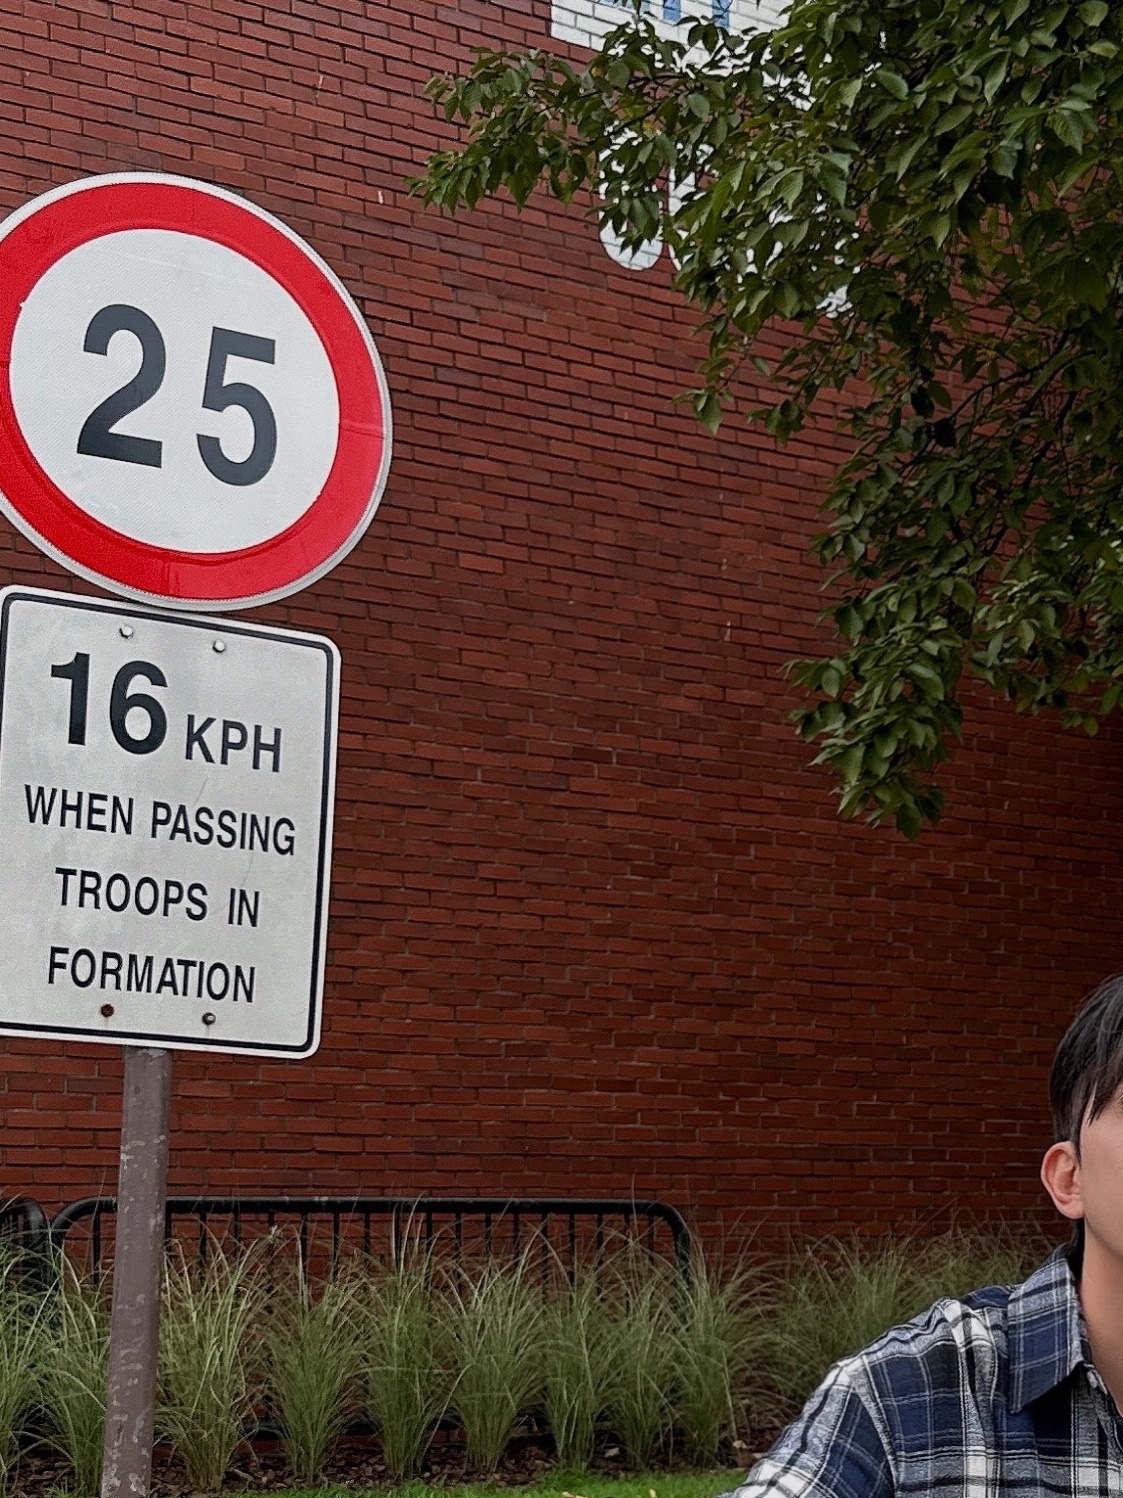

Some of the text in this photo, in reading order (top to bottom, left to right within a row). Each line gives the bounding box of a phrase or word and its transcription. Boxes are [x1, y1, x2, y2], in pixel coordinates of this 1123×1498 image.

[77, 304, 277, 486] 25
[50, 652, 282, 773] 16 KPH
[24, 784, 296, 856] WHEN PASSING
[54, 866, 260, 928] TROOPS IN
[47, 945, 256, 1004] FORMATION
